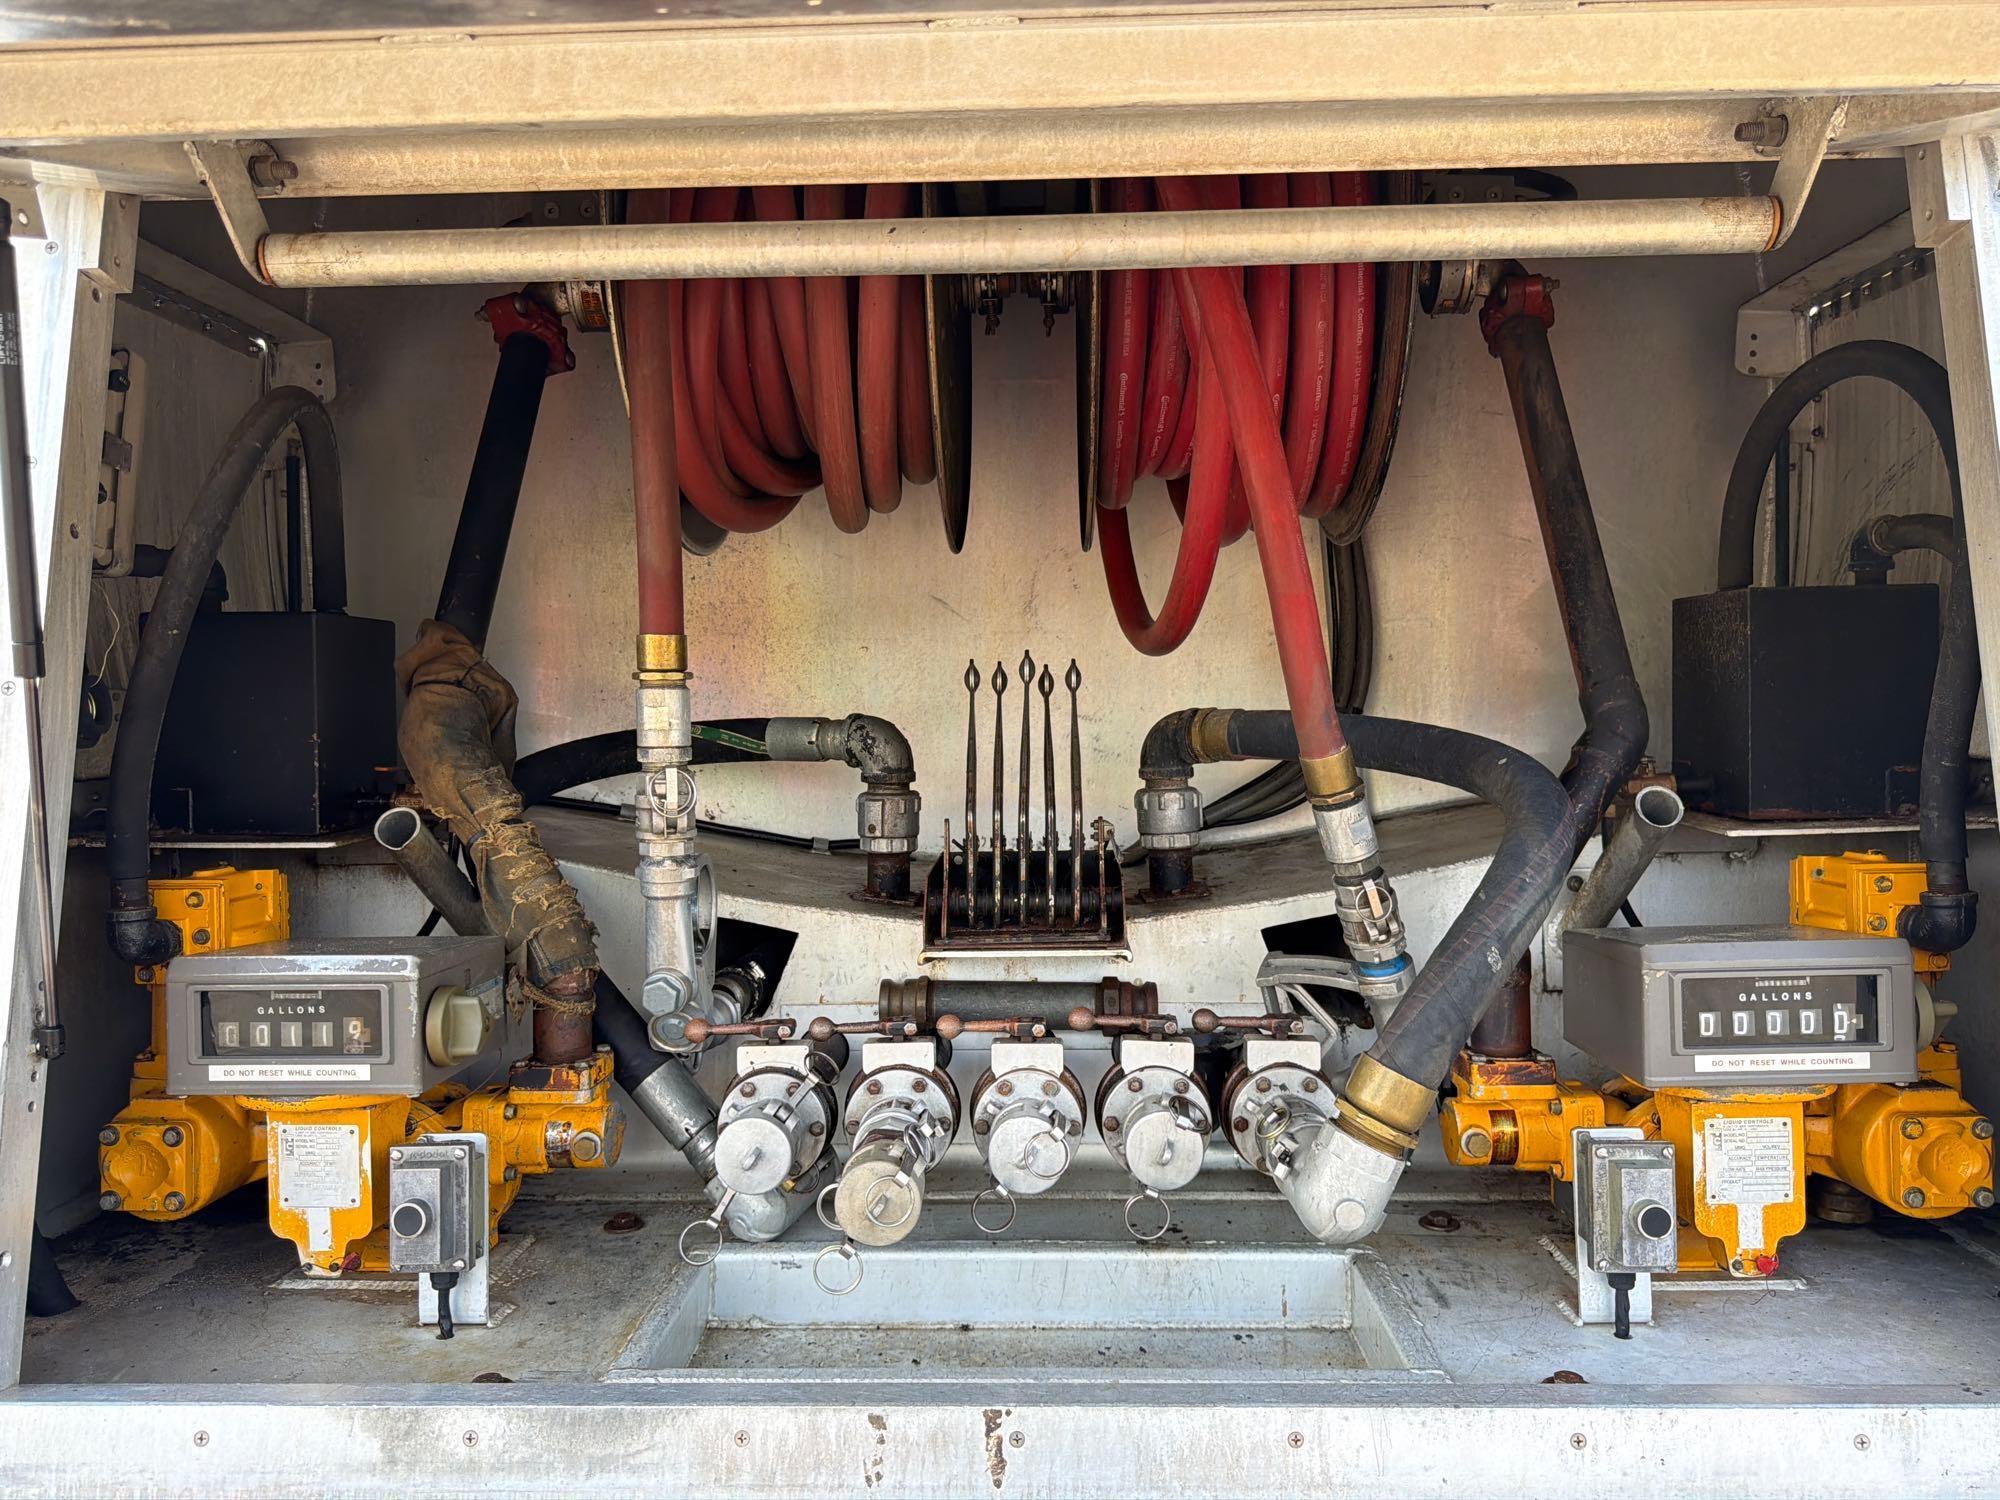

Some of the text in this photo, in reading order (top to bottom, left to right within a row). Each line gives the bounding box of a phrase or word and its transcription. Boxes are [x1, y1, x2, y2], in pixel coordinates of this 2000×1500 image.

[1739, 991, 1812, 1002] GALLONS
[257, 1006, 326, 1015] GALLONS
[1728, 1059, 1745, 1067] NOT
[1780, 1058, 1806, 1066] WHILE
[223, 1069, 357, 1077] DO NOT RESET WHILE COUNTING
